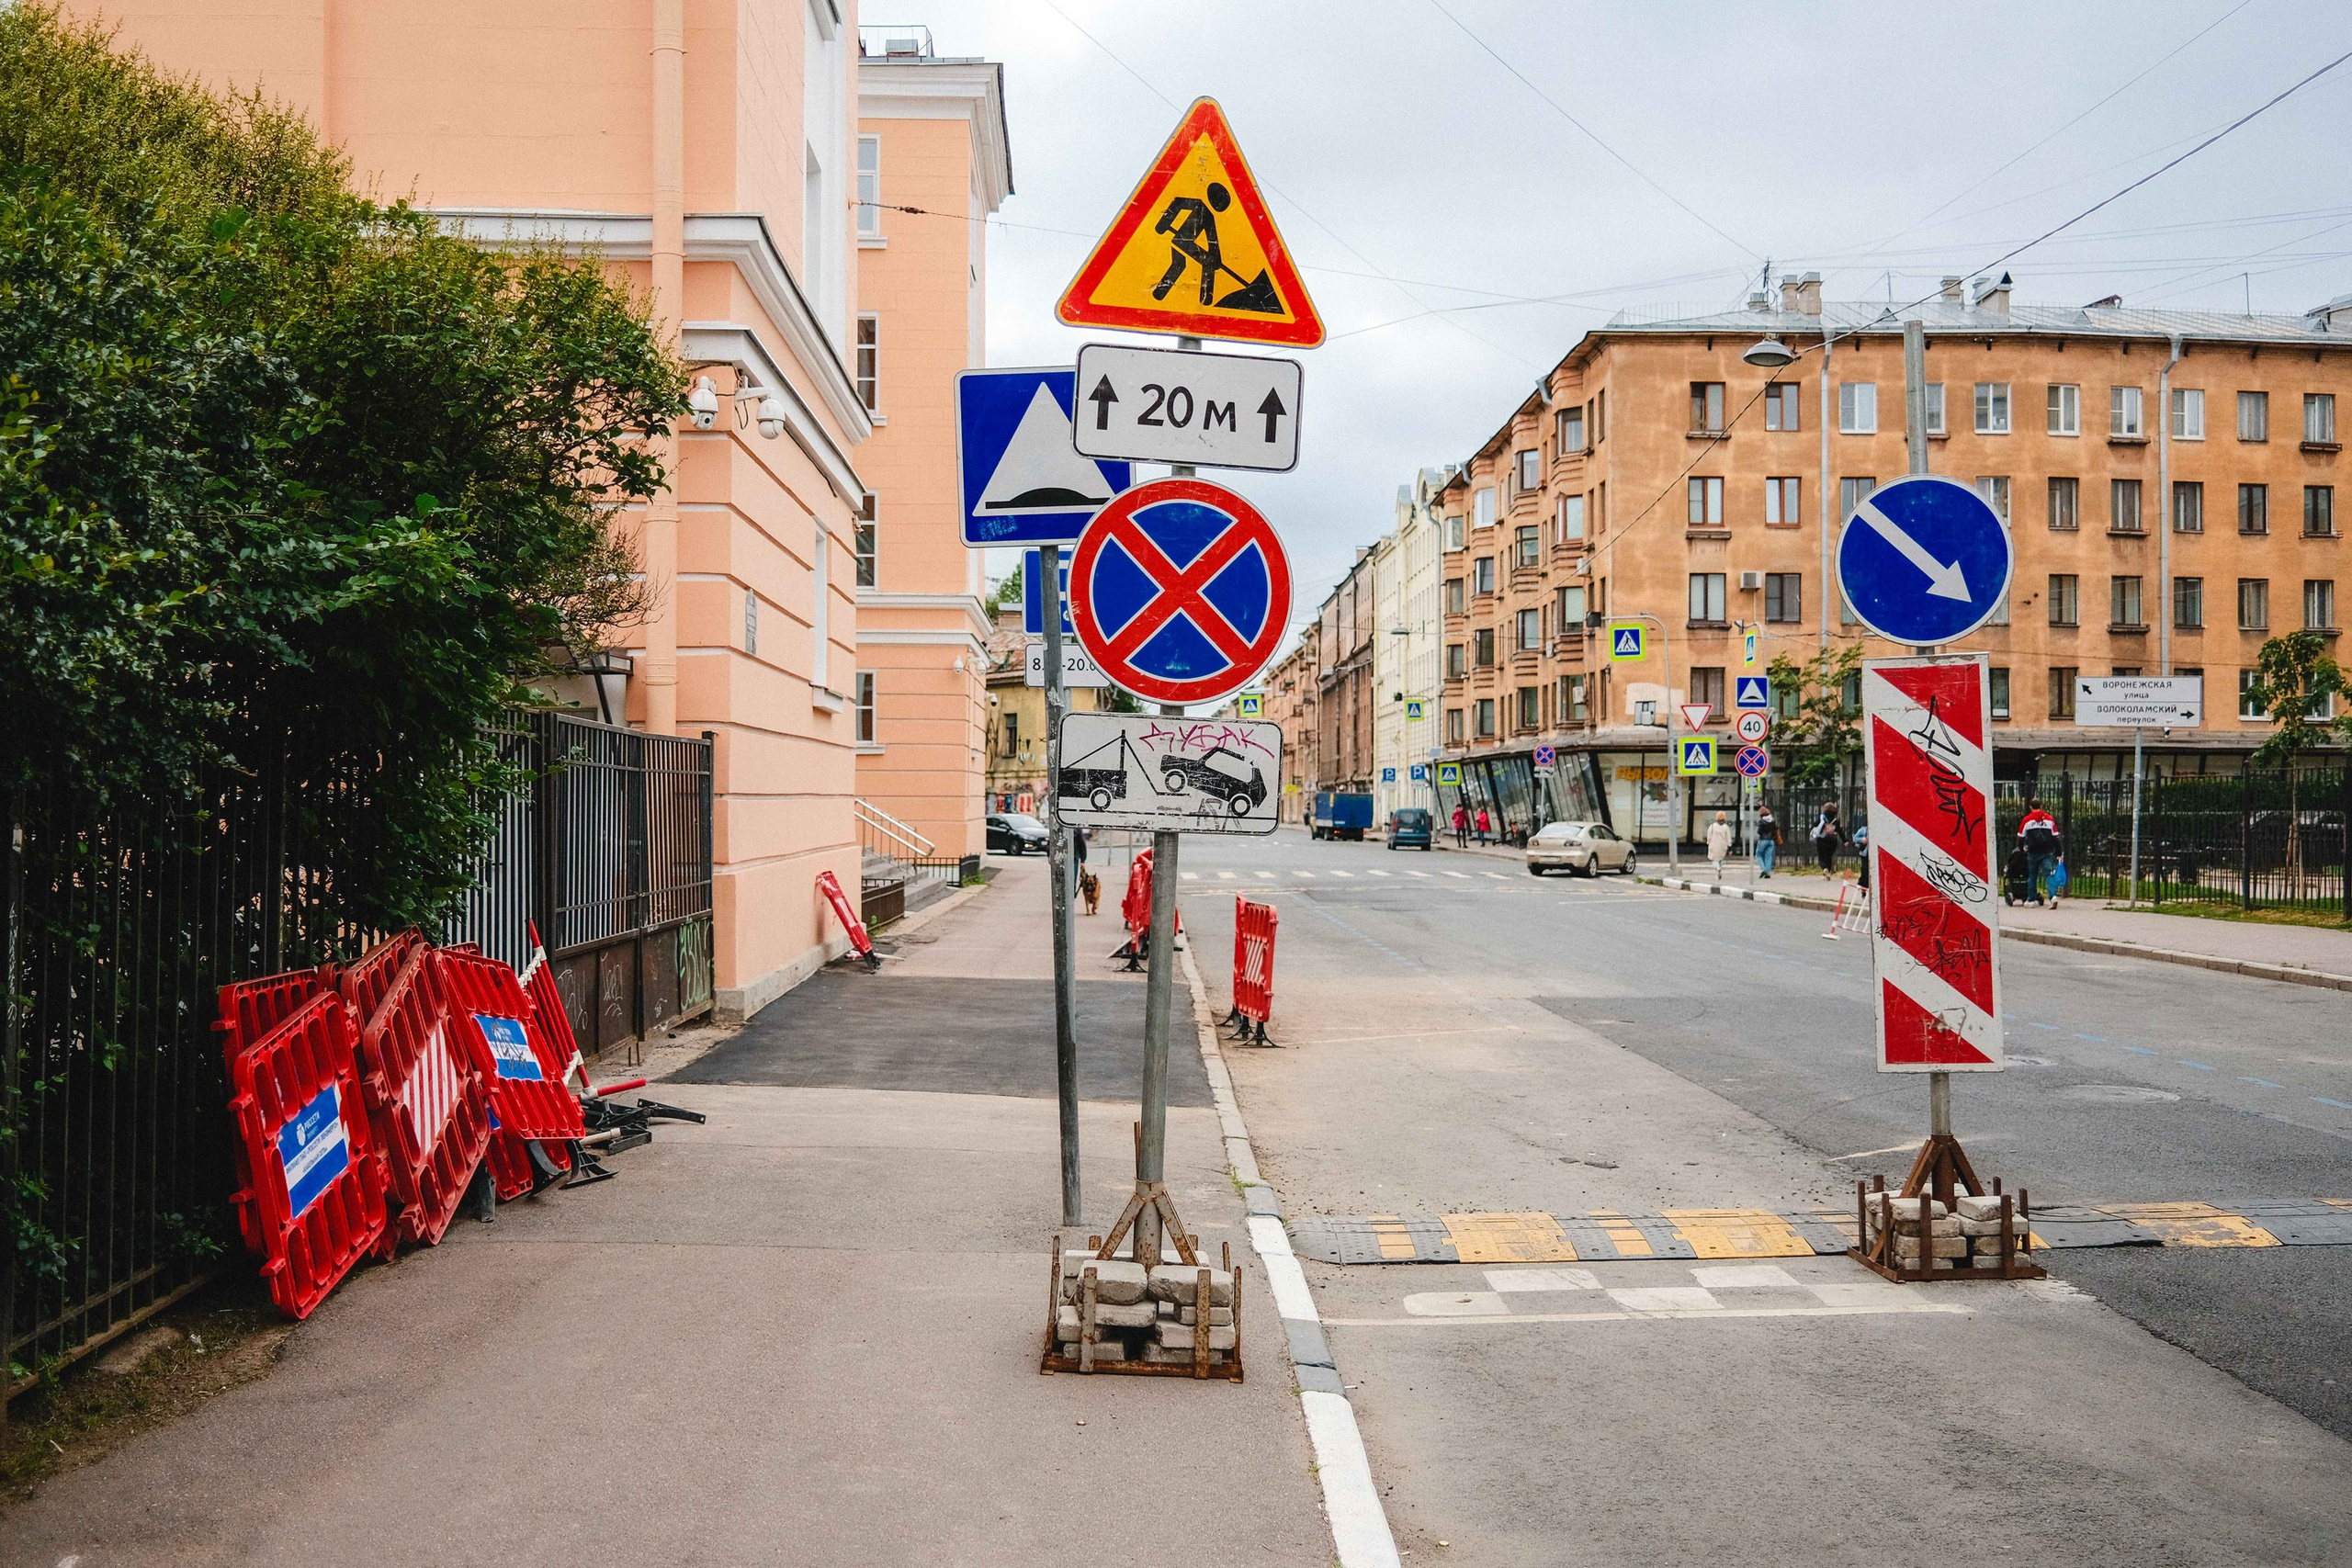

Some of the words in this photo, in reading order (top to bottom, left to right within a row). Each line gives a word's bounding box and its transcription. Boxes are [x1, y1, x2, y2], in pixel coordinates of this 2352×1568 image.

[1137, 383, 1194, 428] 20
[2102, 681, 2172, 689] ВОРОНЕЖСКАЯ
[2097, 704, 2177, 713] ВОЛОКОЛАМСКИЙ
[1743, 720, 1761, 733] 40
